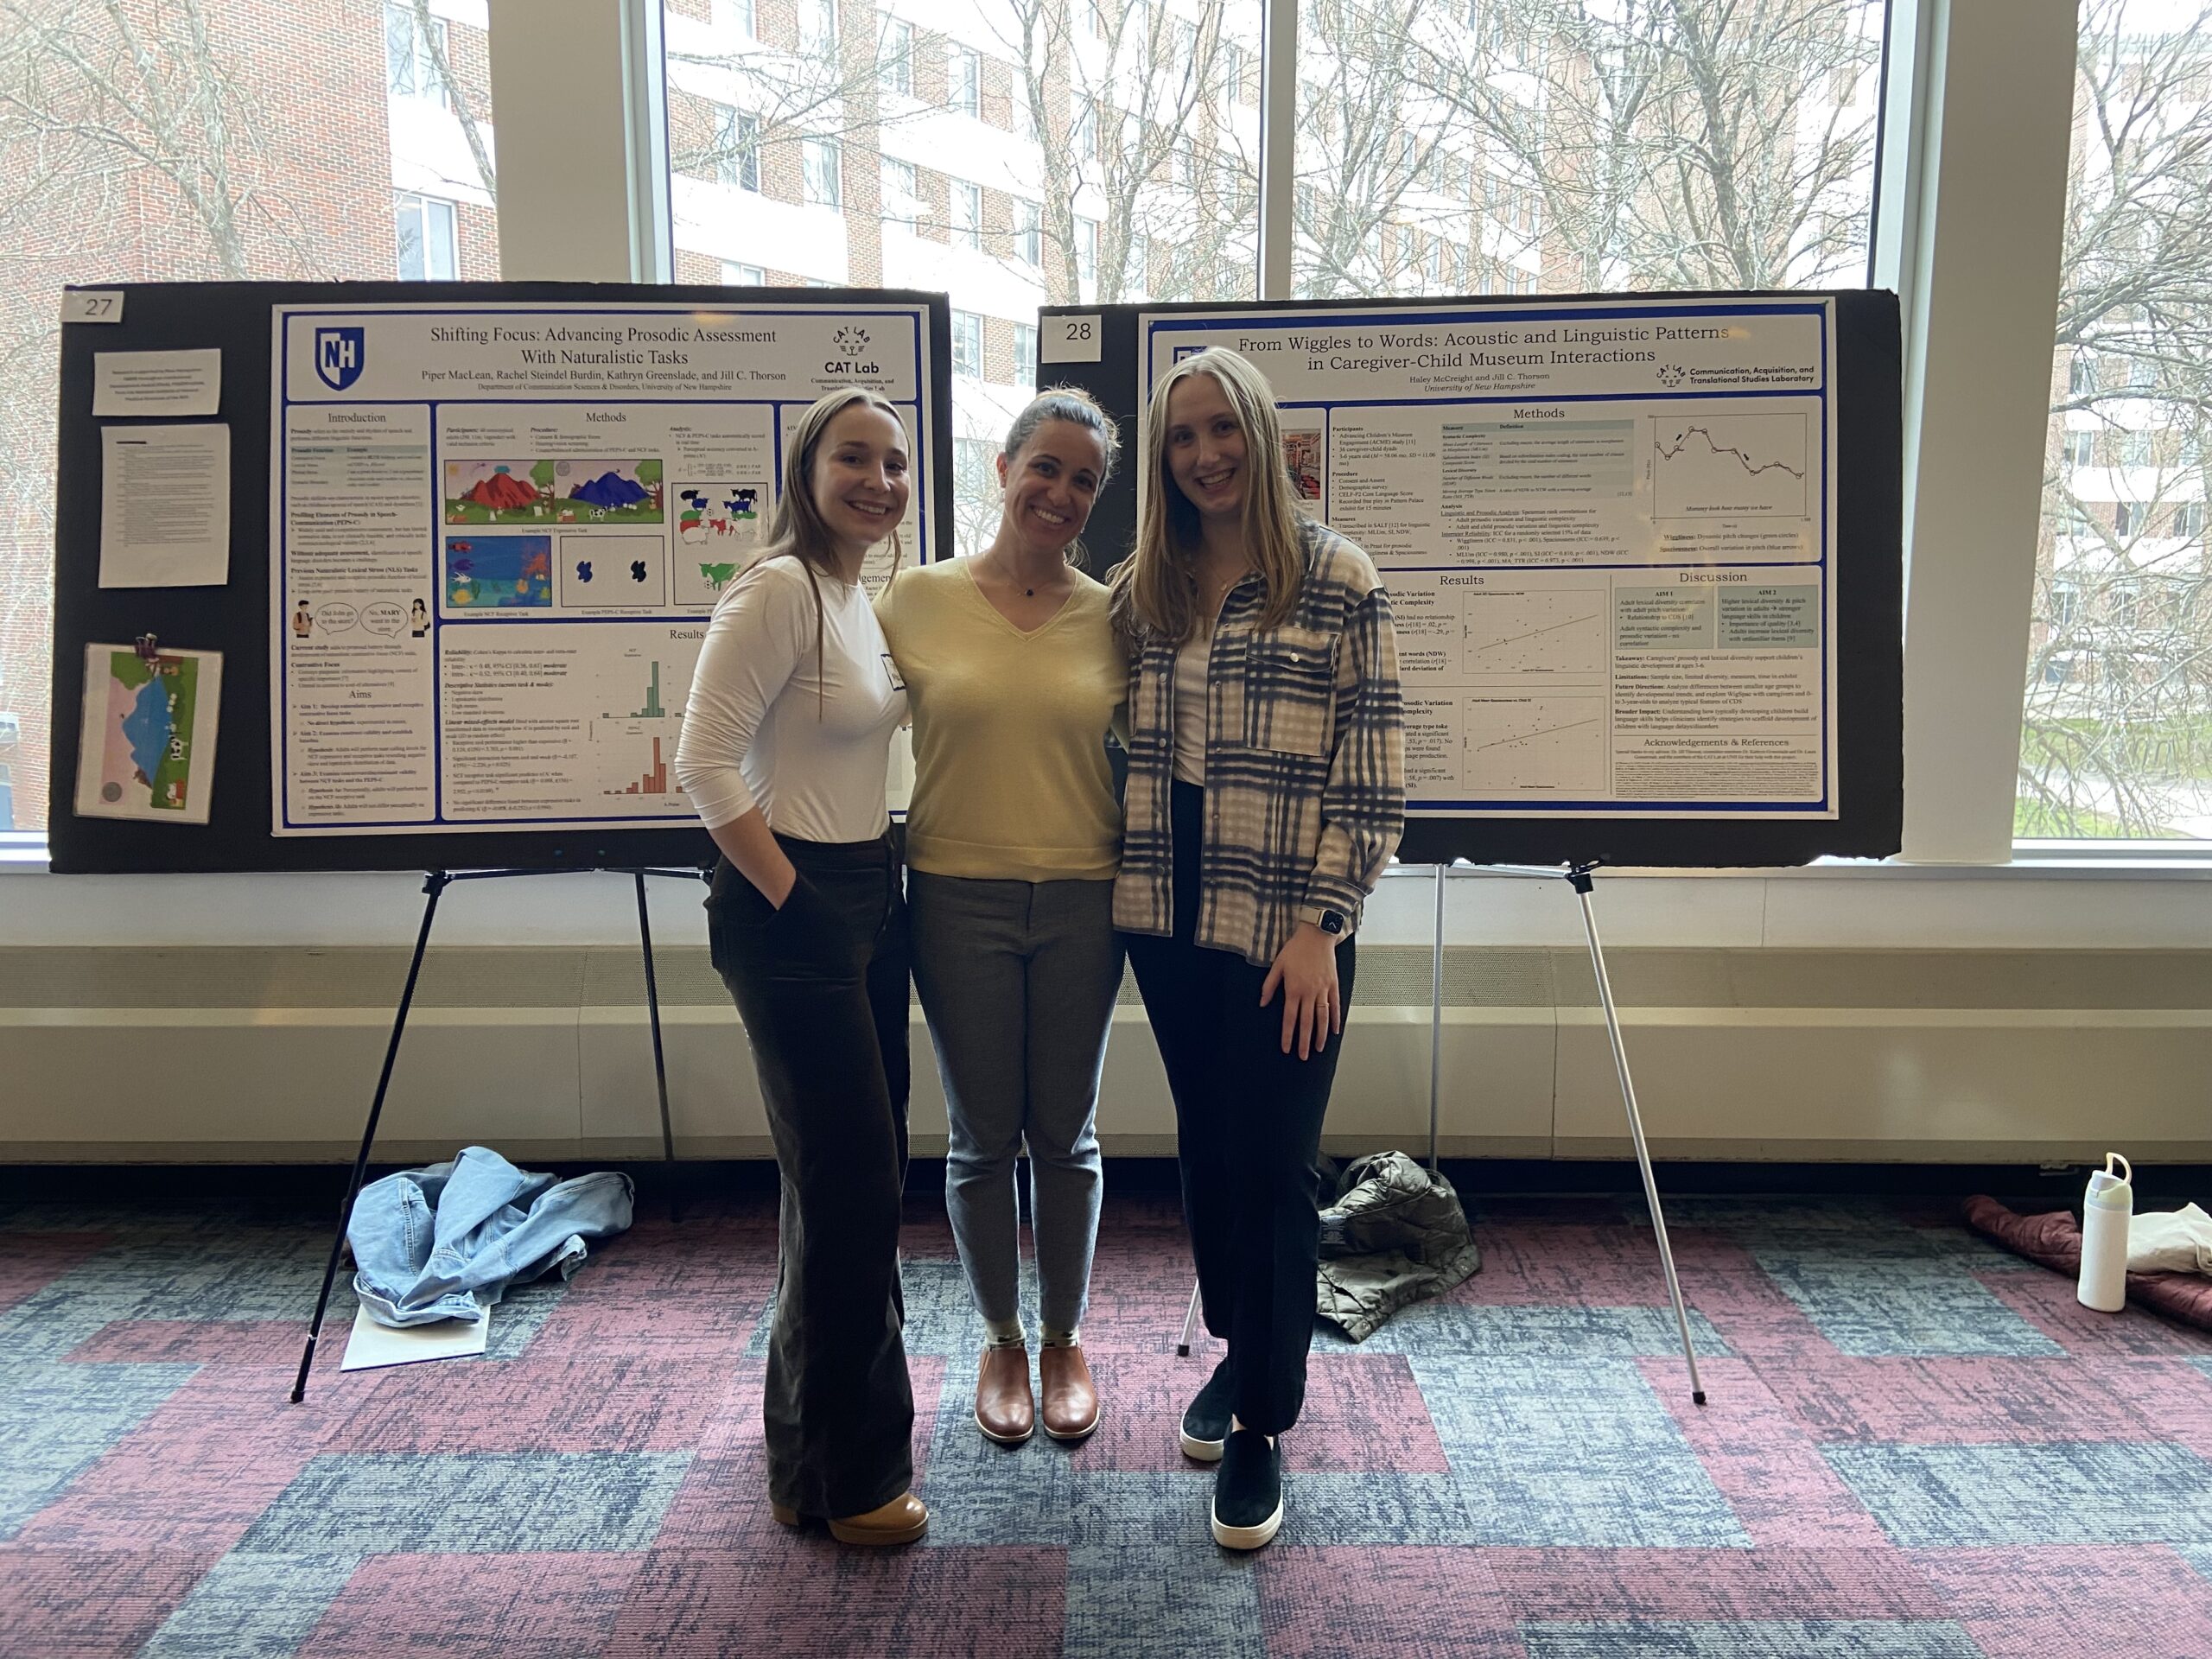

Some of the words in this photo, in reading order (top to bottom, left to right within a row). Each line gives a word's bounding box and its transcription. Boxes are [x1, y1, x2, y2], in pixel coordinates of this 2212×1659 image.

[85, 299, 112, 315] 27
[431, 327, 488, 345] Shifting
[493, 327, 540, 341] Focus:
[545, 327, 622, 345] Advancing
[627, 327, 690, 342] Prosodic
[694, 327, 777, 342] Assessment
[833, 327, 849, 343] CAT
[854, 327, 870, 343] LAB
[1066, 323, 1091, 340] 28
[1239, 338, 1281, 351] From
[1288, 335, 1351, 353] Wiggles
[1358, 336, 1373, 348] to
[1379, 334, 1438, 347] Words:
[1445, 330, 1518, 346] Acoustic
[1524, 330, 1556, 344] and
[1564, 327, 1649, 346] Linguistic
[1656, 327, 1729, 340] Patterns
[325, 340, 354, 367] NH
[522, 350, 556, 364] With
[561, 350, 643, 364] Naturalistic
[648, 350, 689, 365] Tasks
[1307, 357, 1323, 370] in
[1330, 353, 1462, 372] Caregiver-Child
[1469, 353, 1543, 366] Museum
[1550, 348, 1656, 364] Interactions
[825, 362, 851, 373] CAT
[855, 361, 879, 373] Lab
[1656, 365, 1669, 378] CAT
[1673, 365, 1686, 378] LAB
[1690, 367, 1751, 376] Communication,
[1753, 366, 1797, 375] Acquisition,
[422, 371, 445, 382] Piper
[448, 371, 493, 381] MacLean,
[497, 370, 528, 380] Rachel
[531, 370, 567, 380] Steindel
[570, 370, 604, 381] Burdin,
[607, 370, 643, 382] Kathryn
[646, 370, 699, 381] Greenslade,
[702, 372, 718, 380] and
[721, 371, 734, 380] Jill
[736, 372, 747, 380] C.
[750, 371, 785, 380] Thorson
[1433, 375, 1472, 384] McCreight
[1690, 376, 1739, 385] Translational
[1771, 375, 1814, 384] Laboratory
[1493, 382, 1535, 391] Hampshire
[328, 412, 386, 423] Introduction
[586, 412, 626, 423] Methods
[1514, 409, 1565, 418] Methods
[1440, 575, 1484, 585] Results
[1680, 572, 1748, 582] Discussion
[670, 629, 704, 639] Results
[349, 690, 372, 699] Aims
